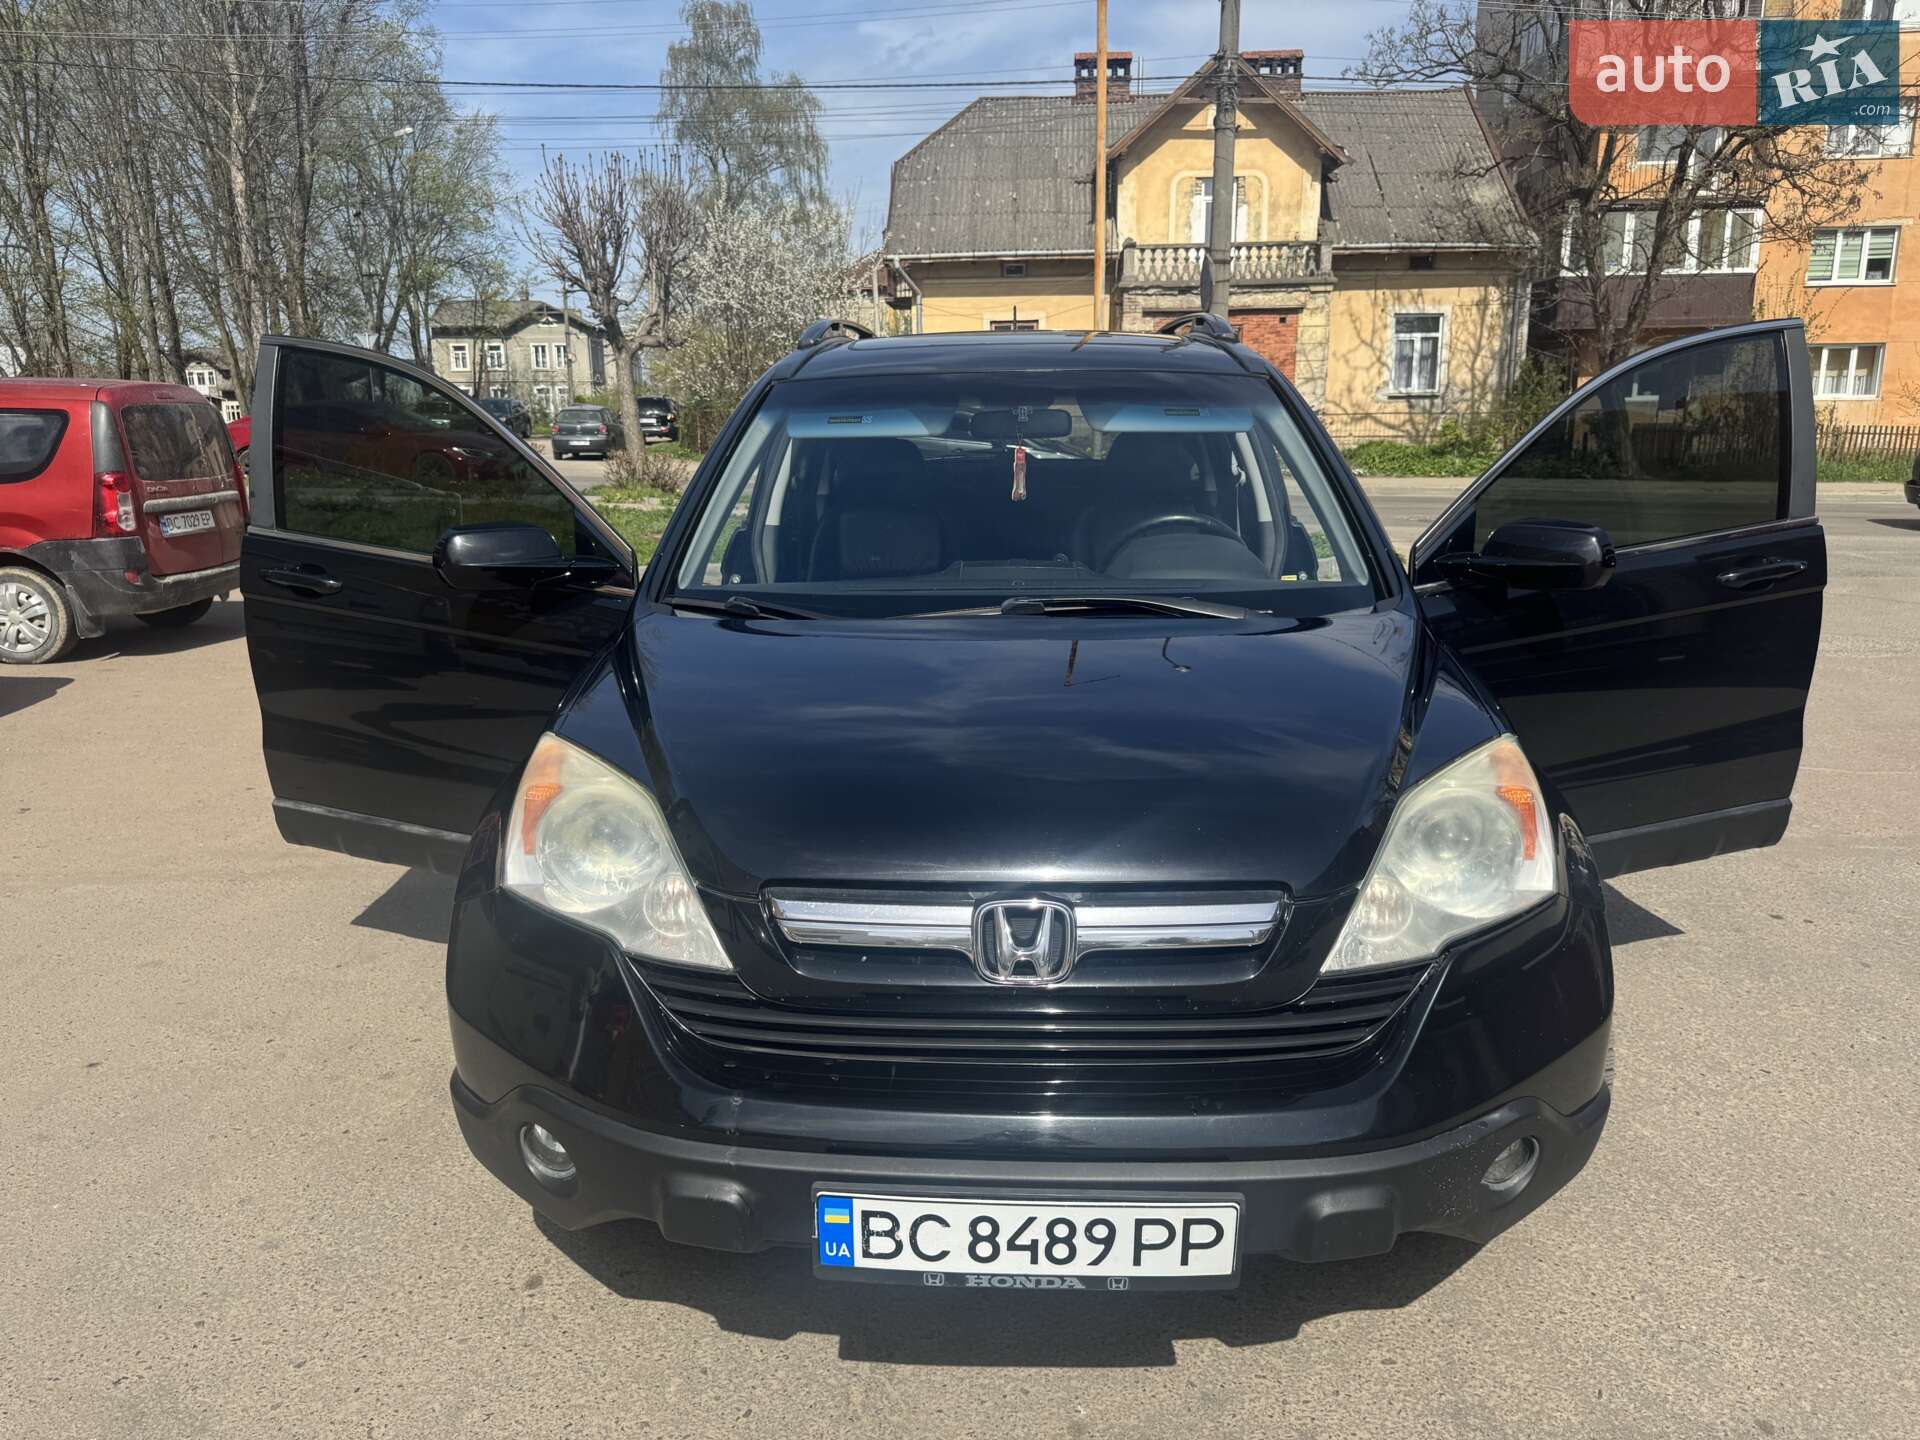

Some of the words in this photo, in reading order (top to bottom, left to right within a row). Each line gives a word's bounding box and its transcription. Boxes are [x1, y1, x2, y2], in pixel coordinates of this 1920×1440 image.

[861, 1209, 951, 1262] BC
[967, 1215, 1117, 1267] 8489
[1132, 1218, 1225, 1267] PP
[825, 1241, 851, 1258] UA
[965, 1274, 1086, 1289] HONDA
